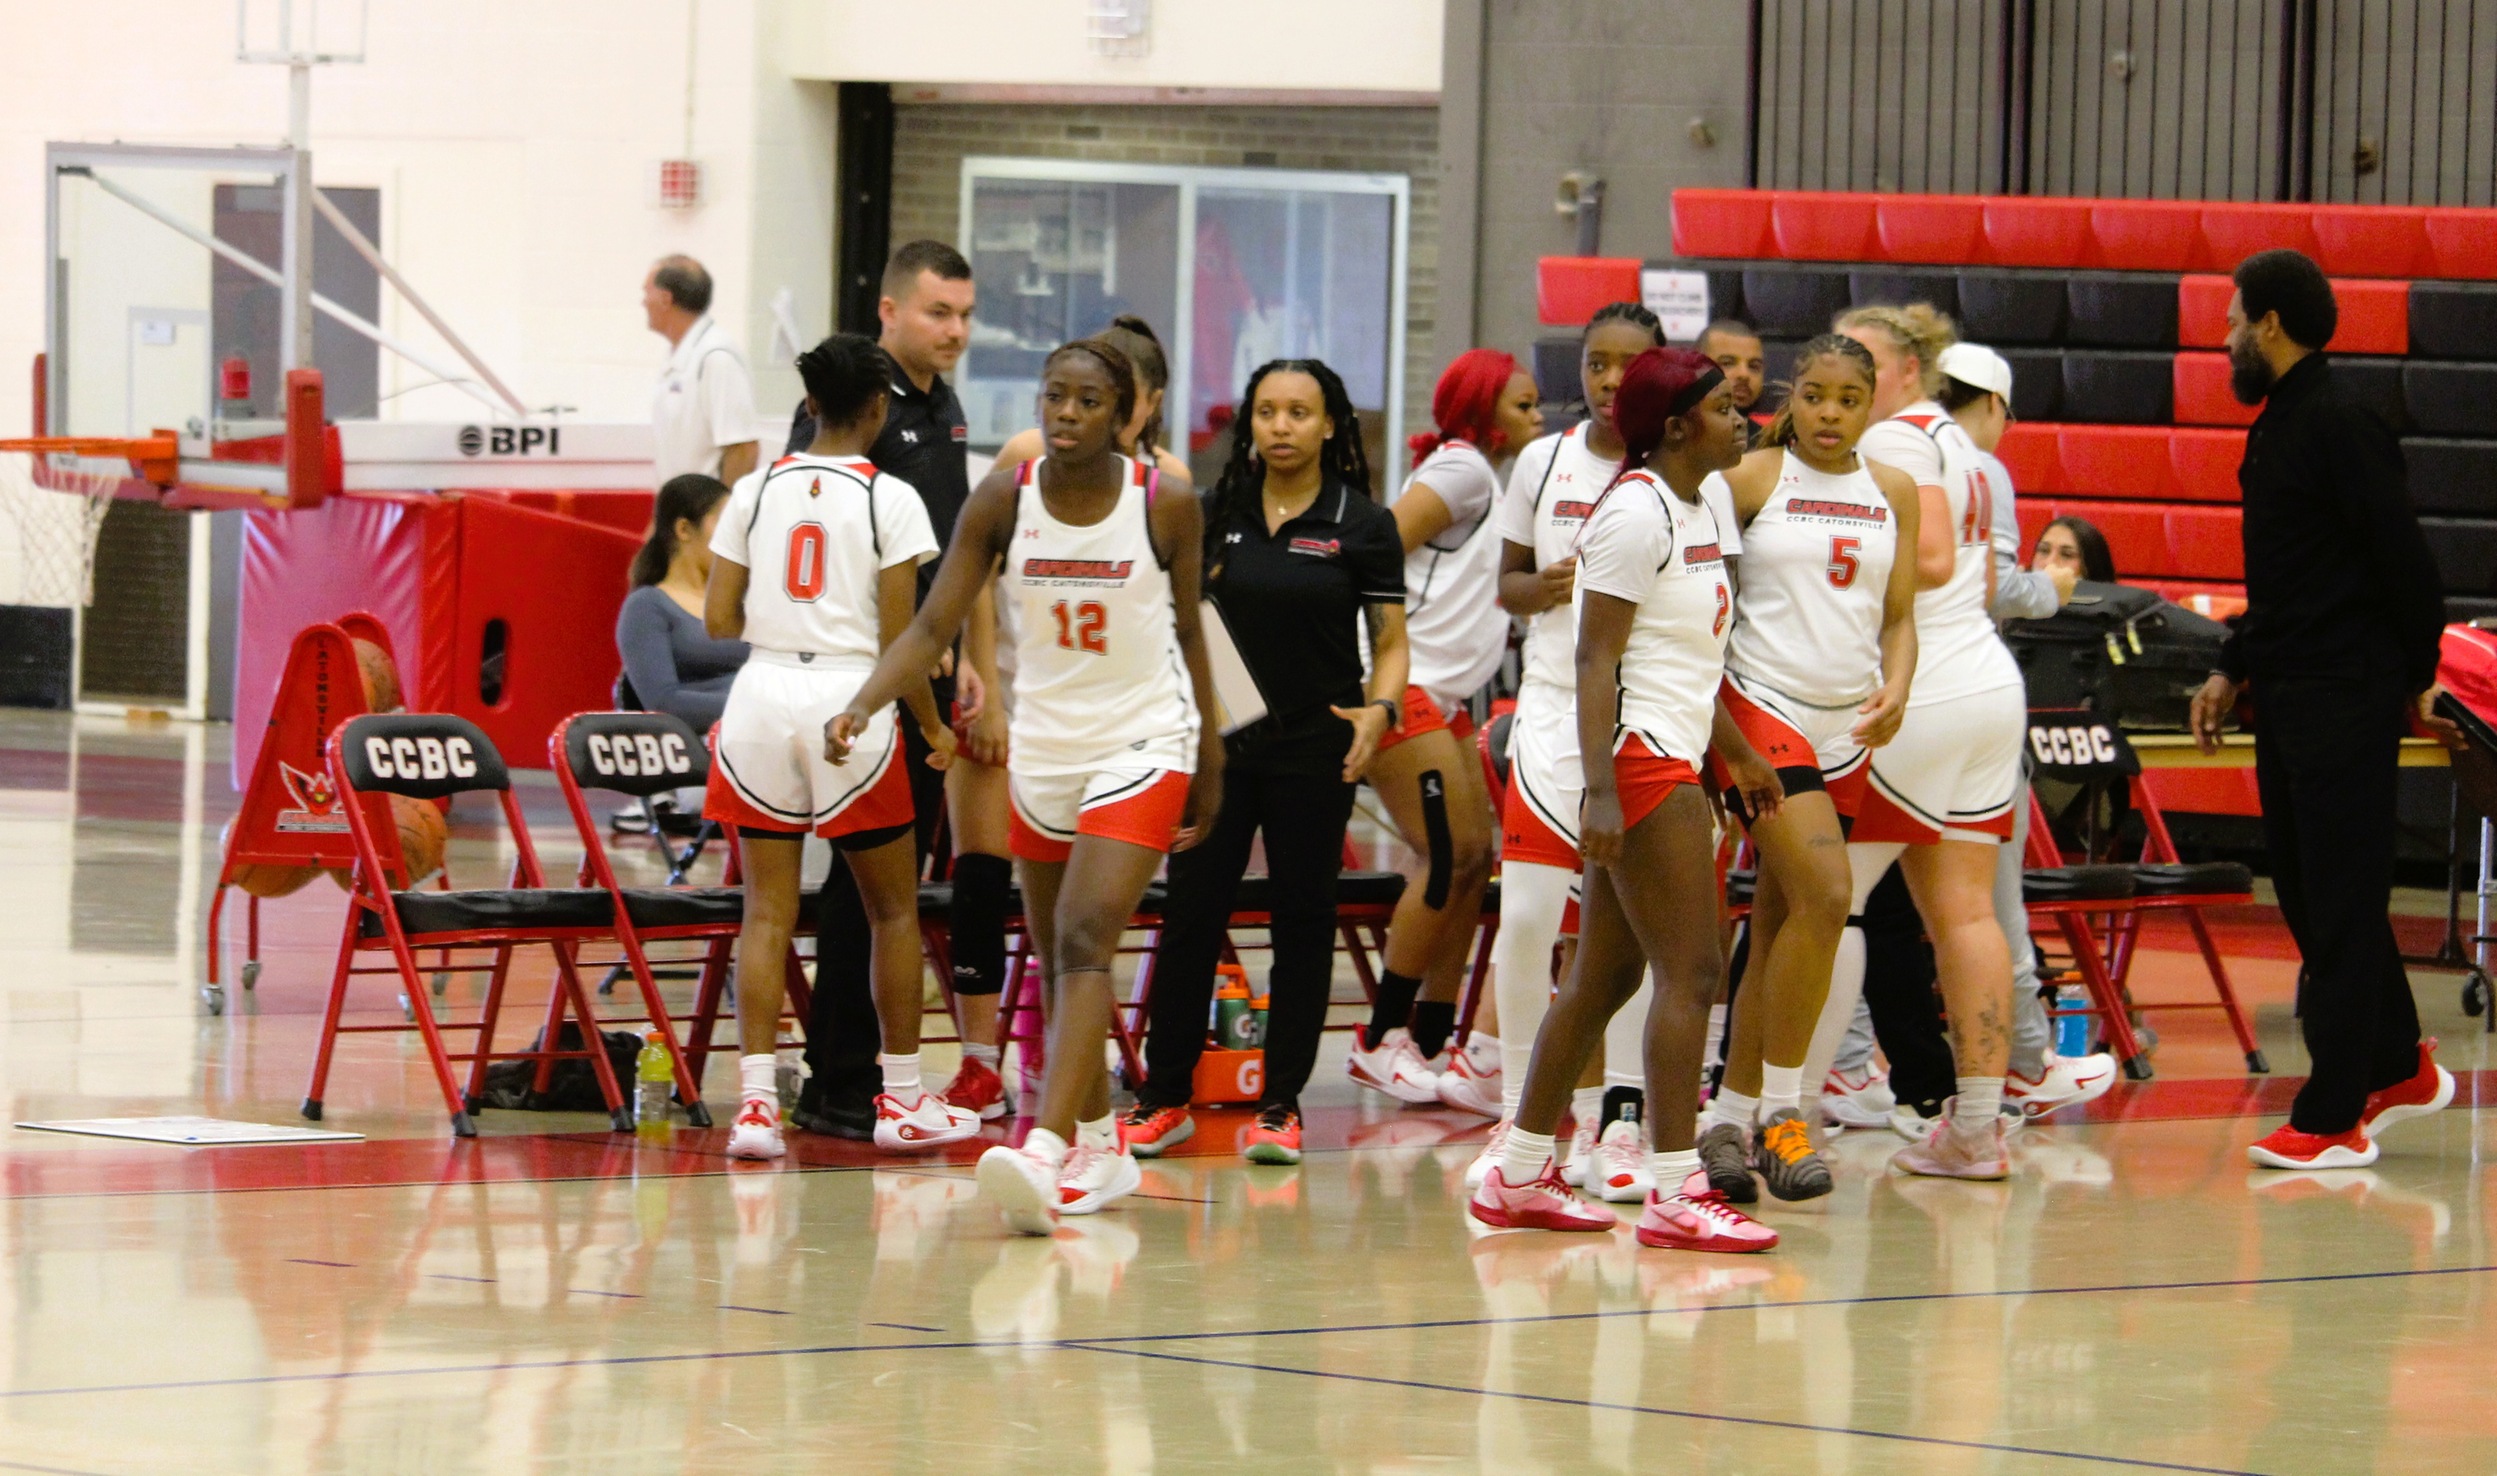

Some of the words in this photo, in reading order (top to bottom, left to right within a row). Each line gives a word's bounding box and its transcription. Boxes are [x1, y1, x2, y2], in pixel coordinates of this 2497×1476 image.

[491, 427, 559, 455] BPI
[1786, 498, 1887, 522] CARDINALS
[1786, 515, 1815, 523] CCBC
[1818, 517, 1884, 531] CATONSVILLE
[783, 520, 829, 604] 0
[1826, 534, 1862, 591] 5
[1050, 599, 1109, 656] 12
[1712, 582, 1729, 639] 2
[365, 736, 478, 780] CCBC
[587, 733, 692, 776] CCBC
[2028, 725, 2117, 765] CCBC
[1237, 1059, 1261, 1095] G
